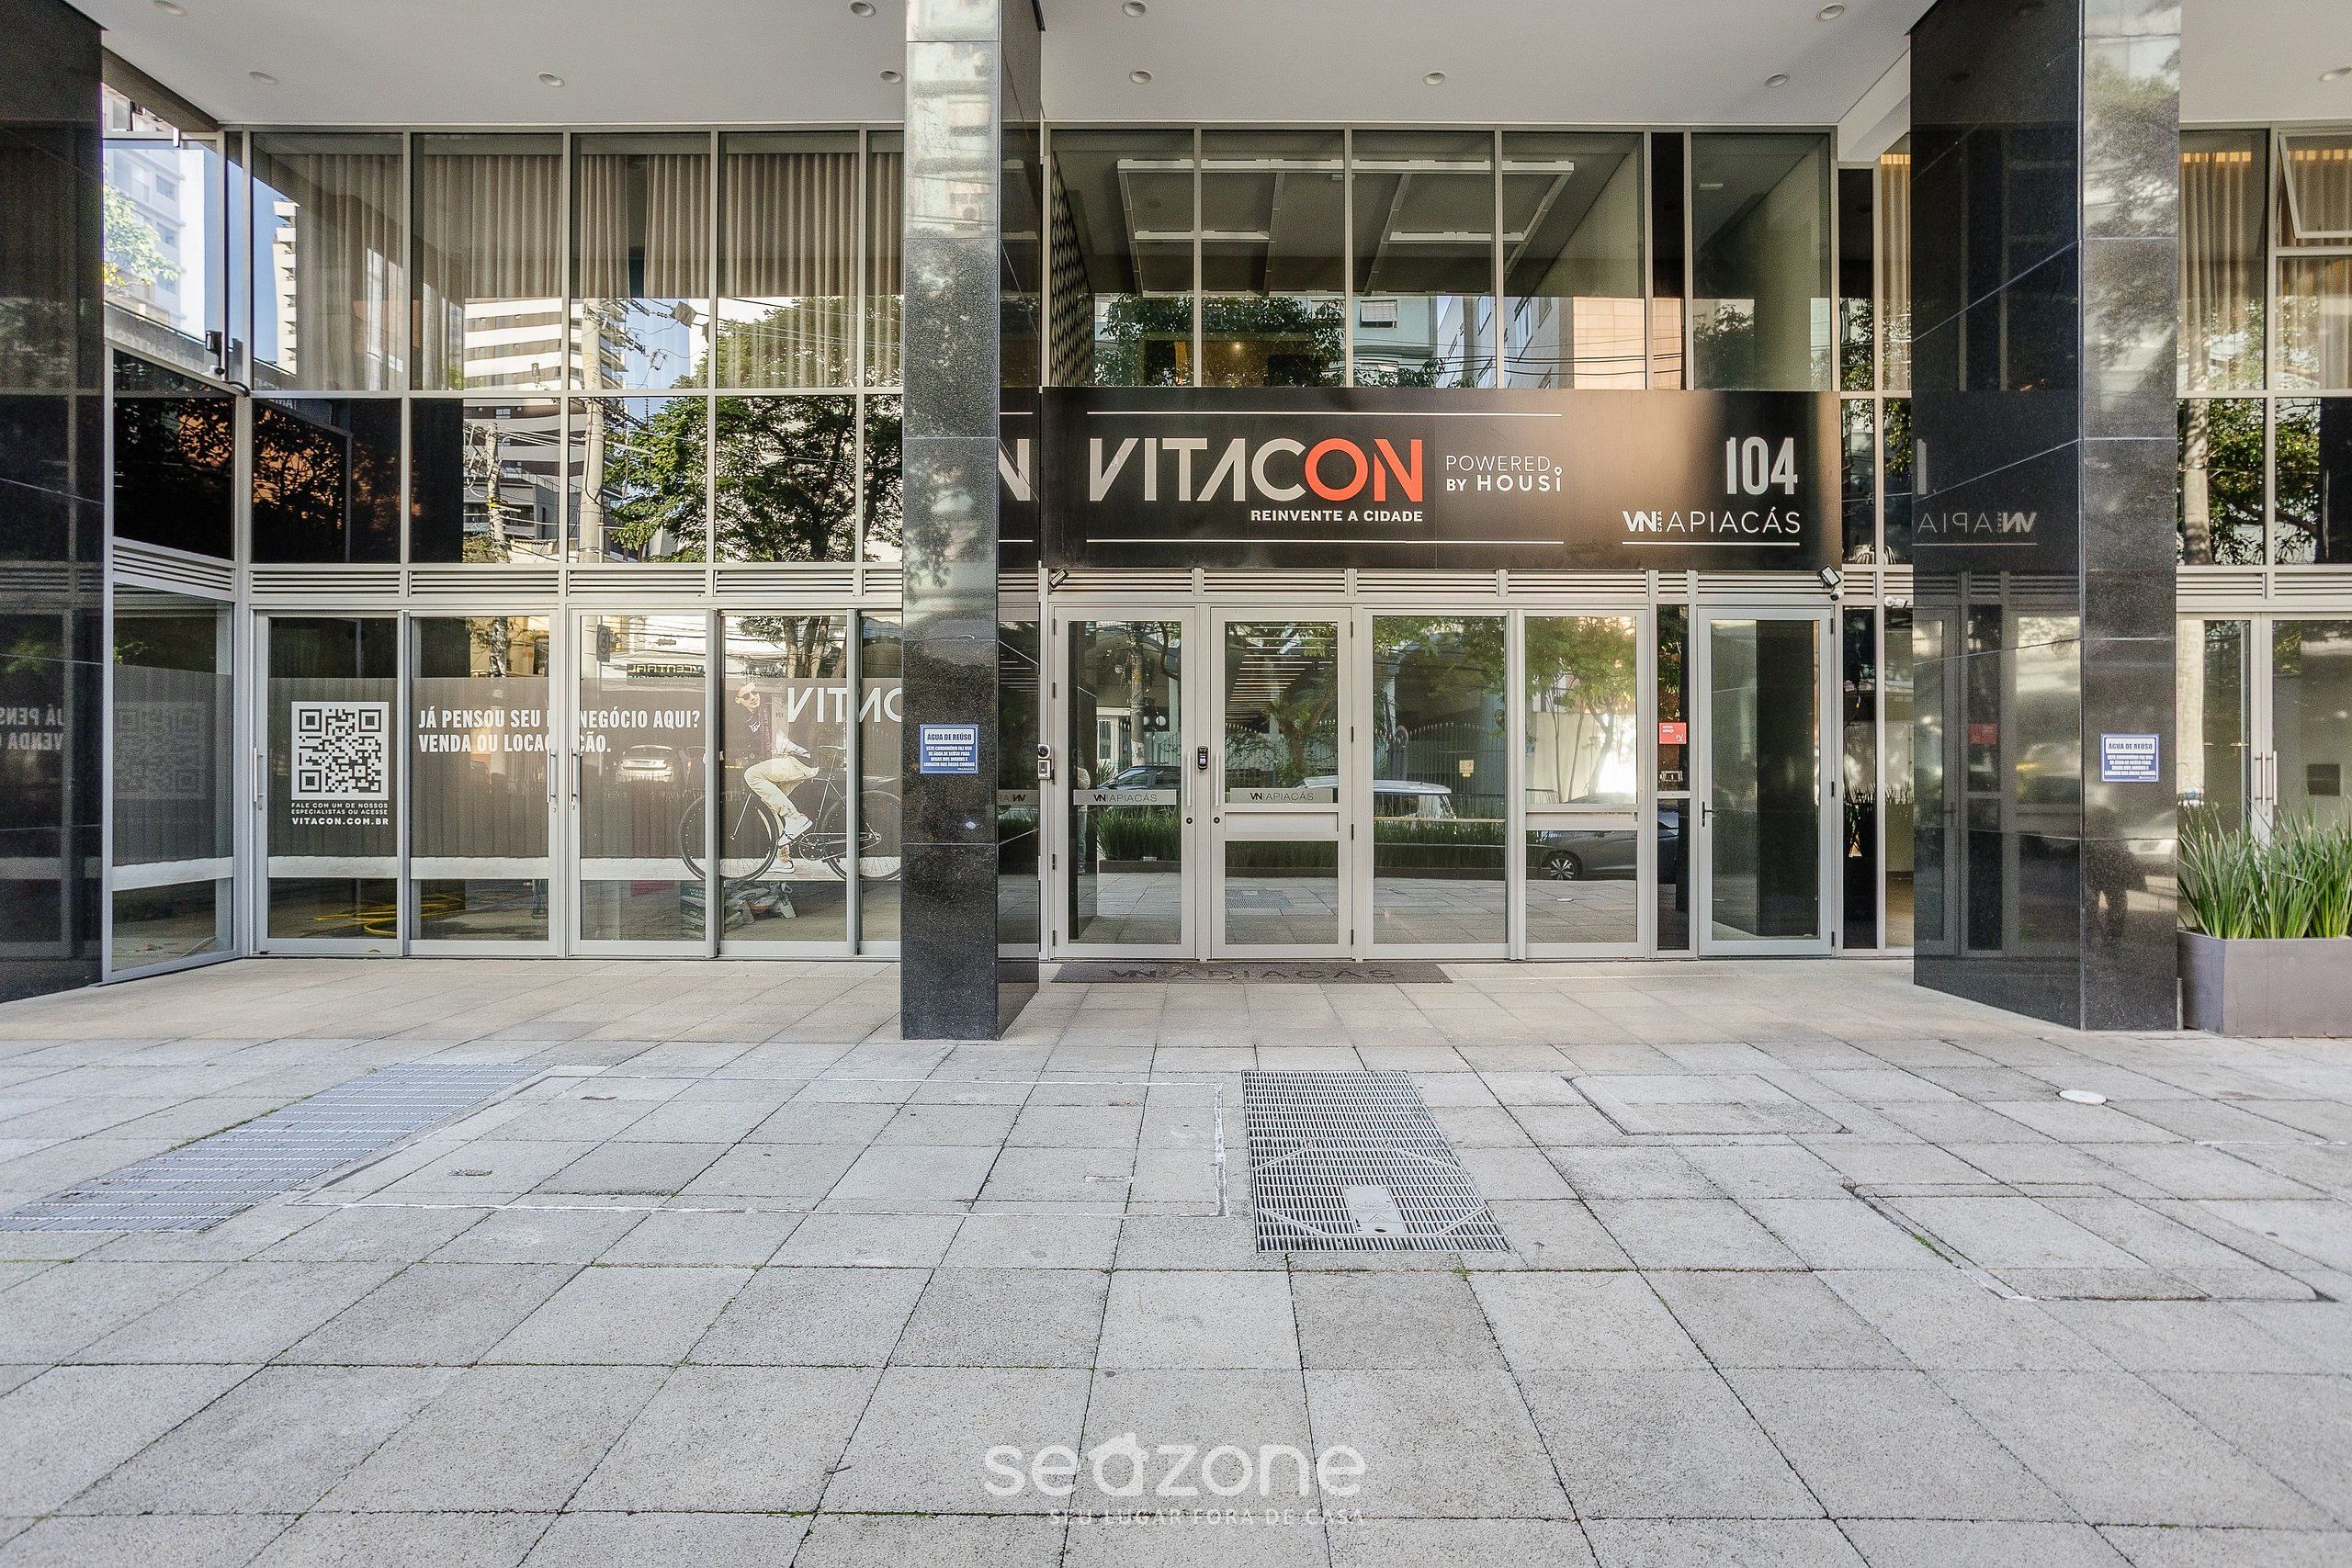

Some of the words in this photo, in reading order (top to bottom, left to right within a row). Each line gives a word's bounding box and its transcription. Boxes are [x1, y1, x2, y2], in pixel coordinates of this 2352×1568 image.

[1090, 438, 1423, 502] VITACON
[1446, 455, 1551, 472] POWERED
[1726, 436, 1798, 495] 104
[1446, 479, 1467, 491] BY
[1250, 510, 1343, 523] REINVENTE
[1347, 511, 1359, 523] A
[1363, 511, 1423, 523] CIDADE
[1666, 506, 1801, 534] APIACÁS
[418, 705, 436, 728] JÁ
[441, 709, 505, 728] PENSOU
[510, 709, 541, 728] SEU
[652, 709, 701, 730] AQUI?
[419, 734, 471, 752] VENDA
[477, 734, 499, 752] OU
[927, 732, 944, 740] ÁGUA
[952, 732, 972, 740] REÚSO
[291, 817, 389, 826] VITACON.COM.BR
